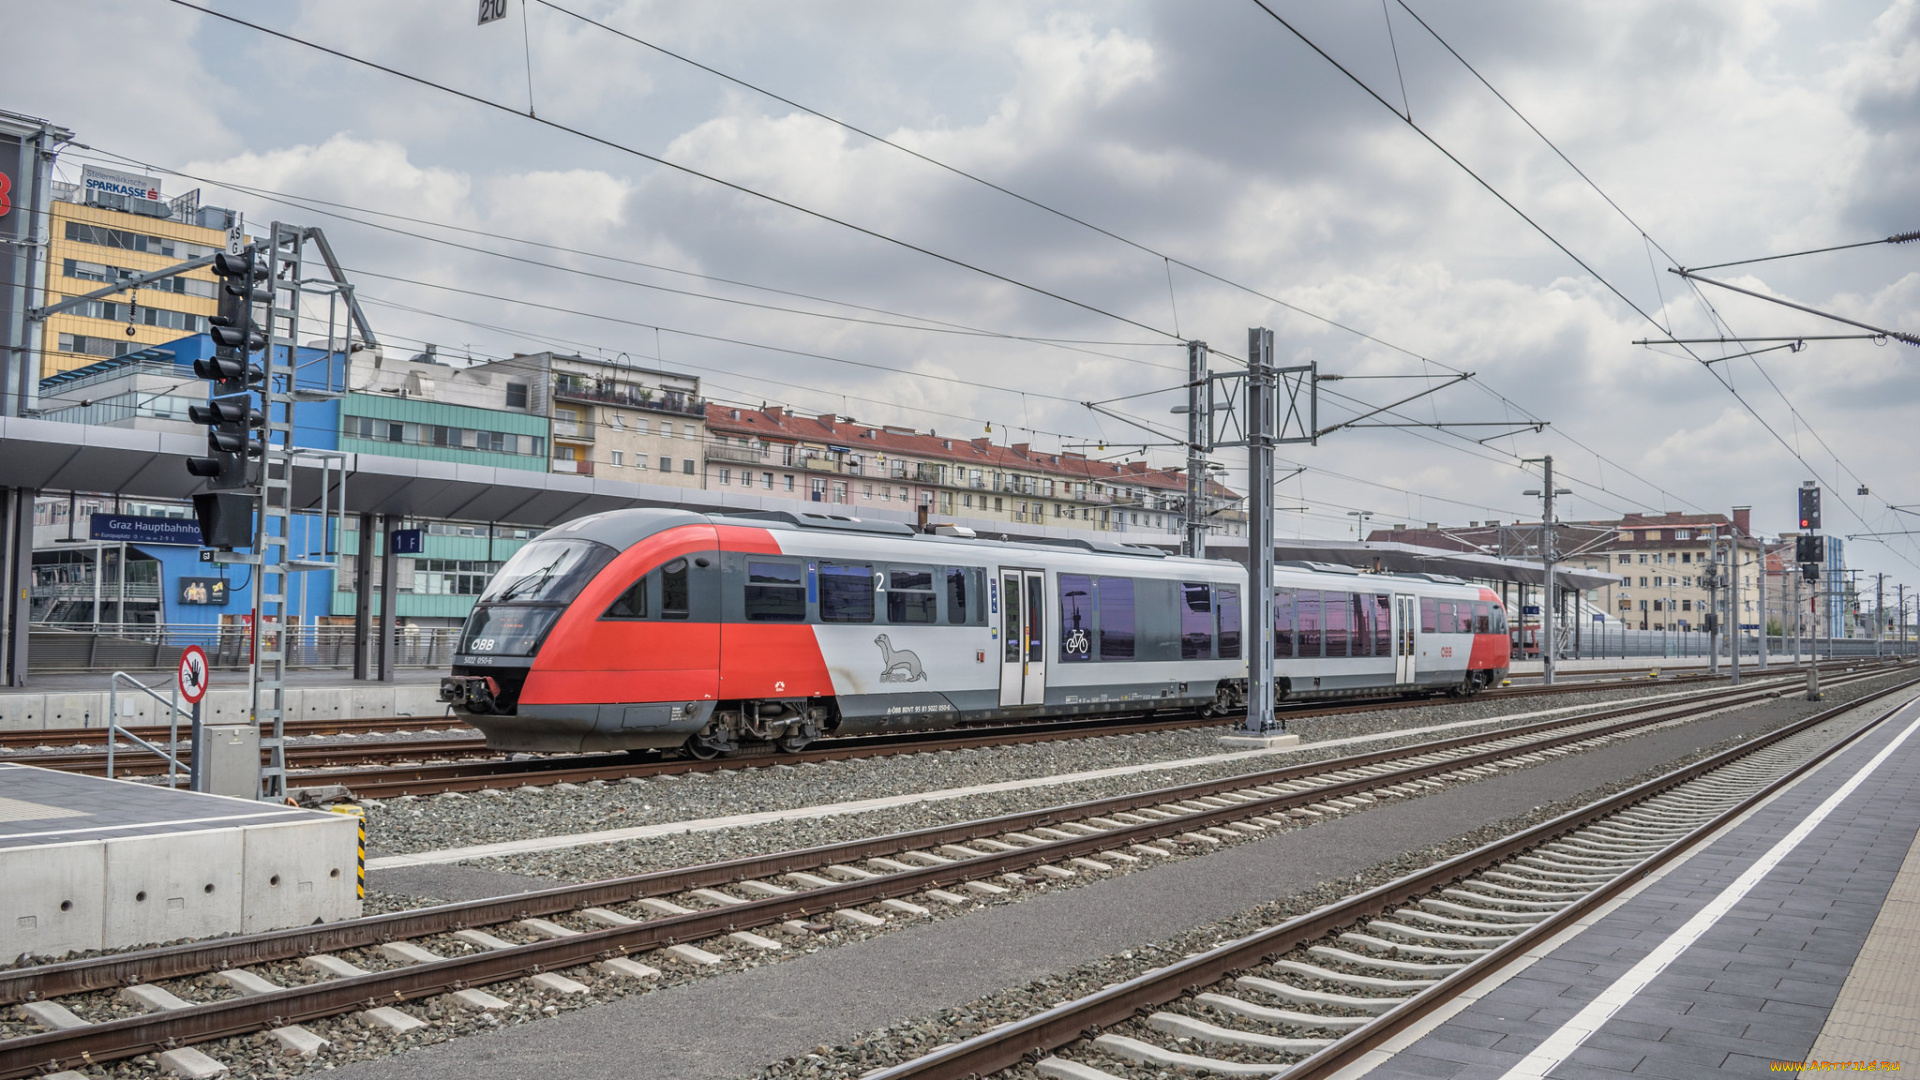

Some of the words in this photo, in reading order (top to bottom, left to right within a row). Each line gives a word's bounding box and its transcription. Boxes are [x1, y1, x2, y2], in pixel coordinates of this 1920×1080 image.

[480, 0, 505, 22] 210
[86, 169, 147, 187] Steiermärkische
[86, 178, 147, 198] SPARKASSE
[230, 227, 241, 240] AS
[109, 520, 132, 530] Graz
[135, 521, 200, 533] Hauptbahnho
[396, 535, 401, 550] 1
[410, 537, 415, 549] F
[875, 572, 885, 592] 2
[1453, 604, 1457, 616] 2
